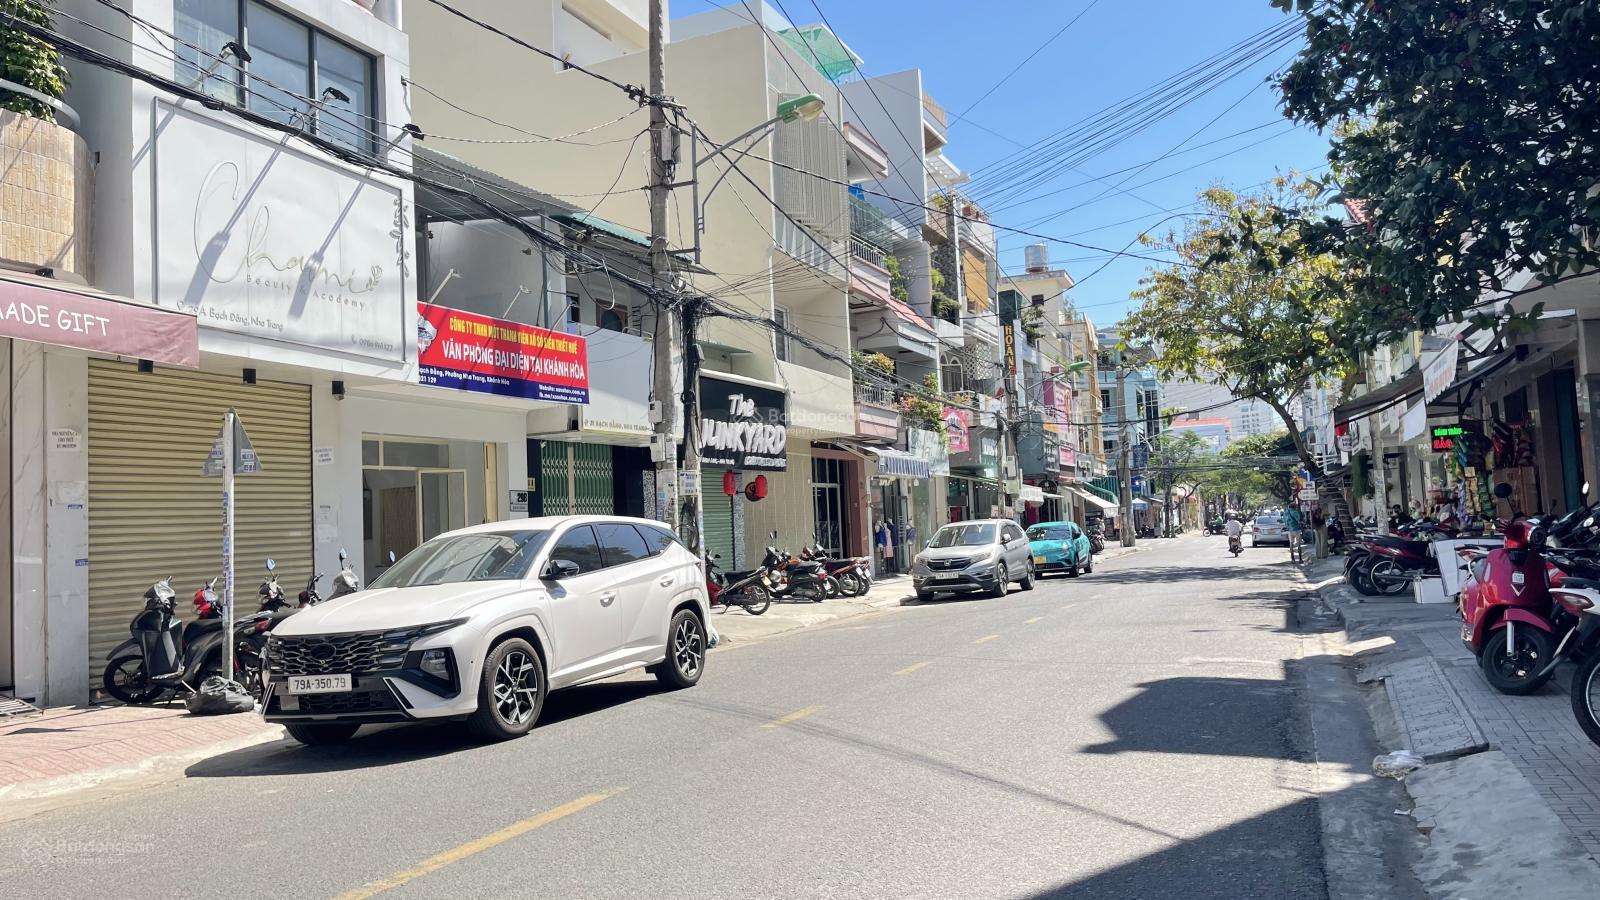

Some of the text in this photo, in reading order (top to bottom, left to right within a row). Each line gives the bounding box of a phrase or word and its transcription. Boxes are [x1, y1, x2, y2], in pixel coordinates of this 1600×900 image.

[247, 274, 292, 294] Beauty
[313, 291, 367, 311] Academy
[0, 302, 110, 336] ADE GIFT
[251, 316, 265, 328] Nha
[267, 318, 285, 333] Trang
[449, 316, 465, 332] CÔNG
[466, 320, 474, 333] TY
[474, 321, 488, 337] TNHH
[489, 323, 499, 341] MỘT
[500, 326, 517, 343] THÀNH
[518, 330, 529, 345] VIÊN
[442, 338, 585, 380] VĂN PHÒNG ĐẠI DIỆN TẠI KHÁNH HÒA
[728, 393, 755, 418] The
[699, 418, 787, 456] JUNKYARD
[295, 677, 346, 691] 79A-350.79
